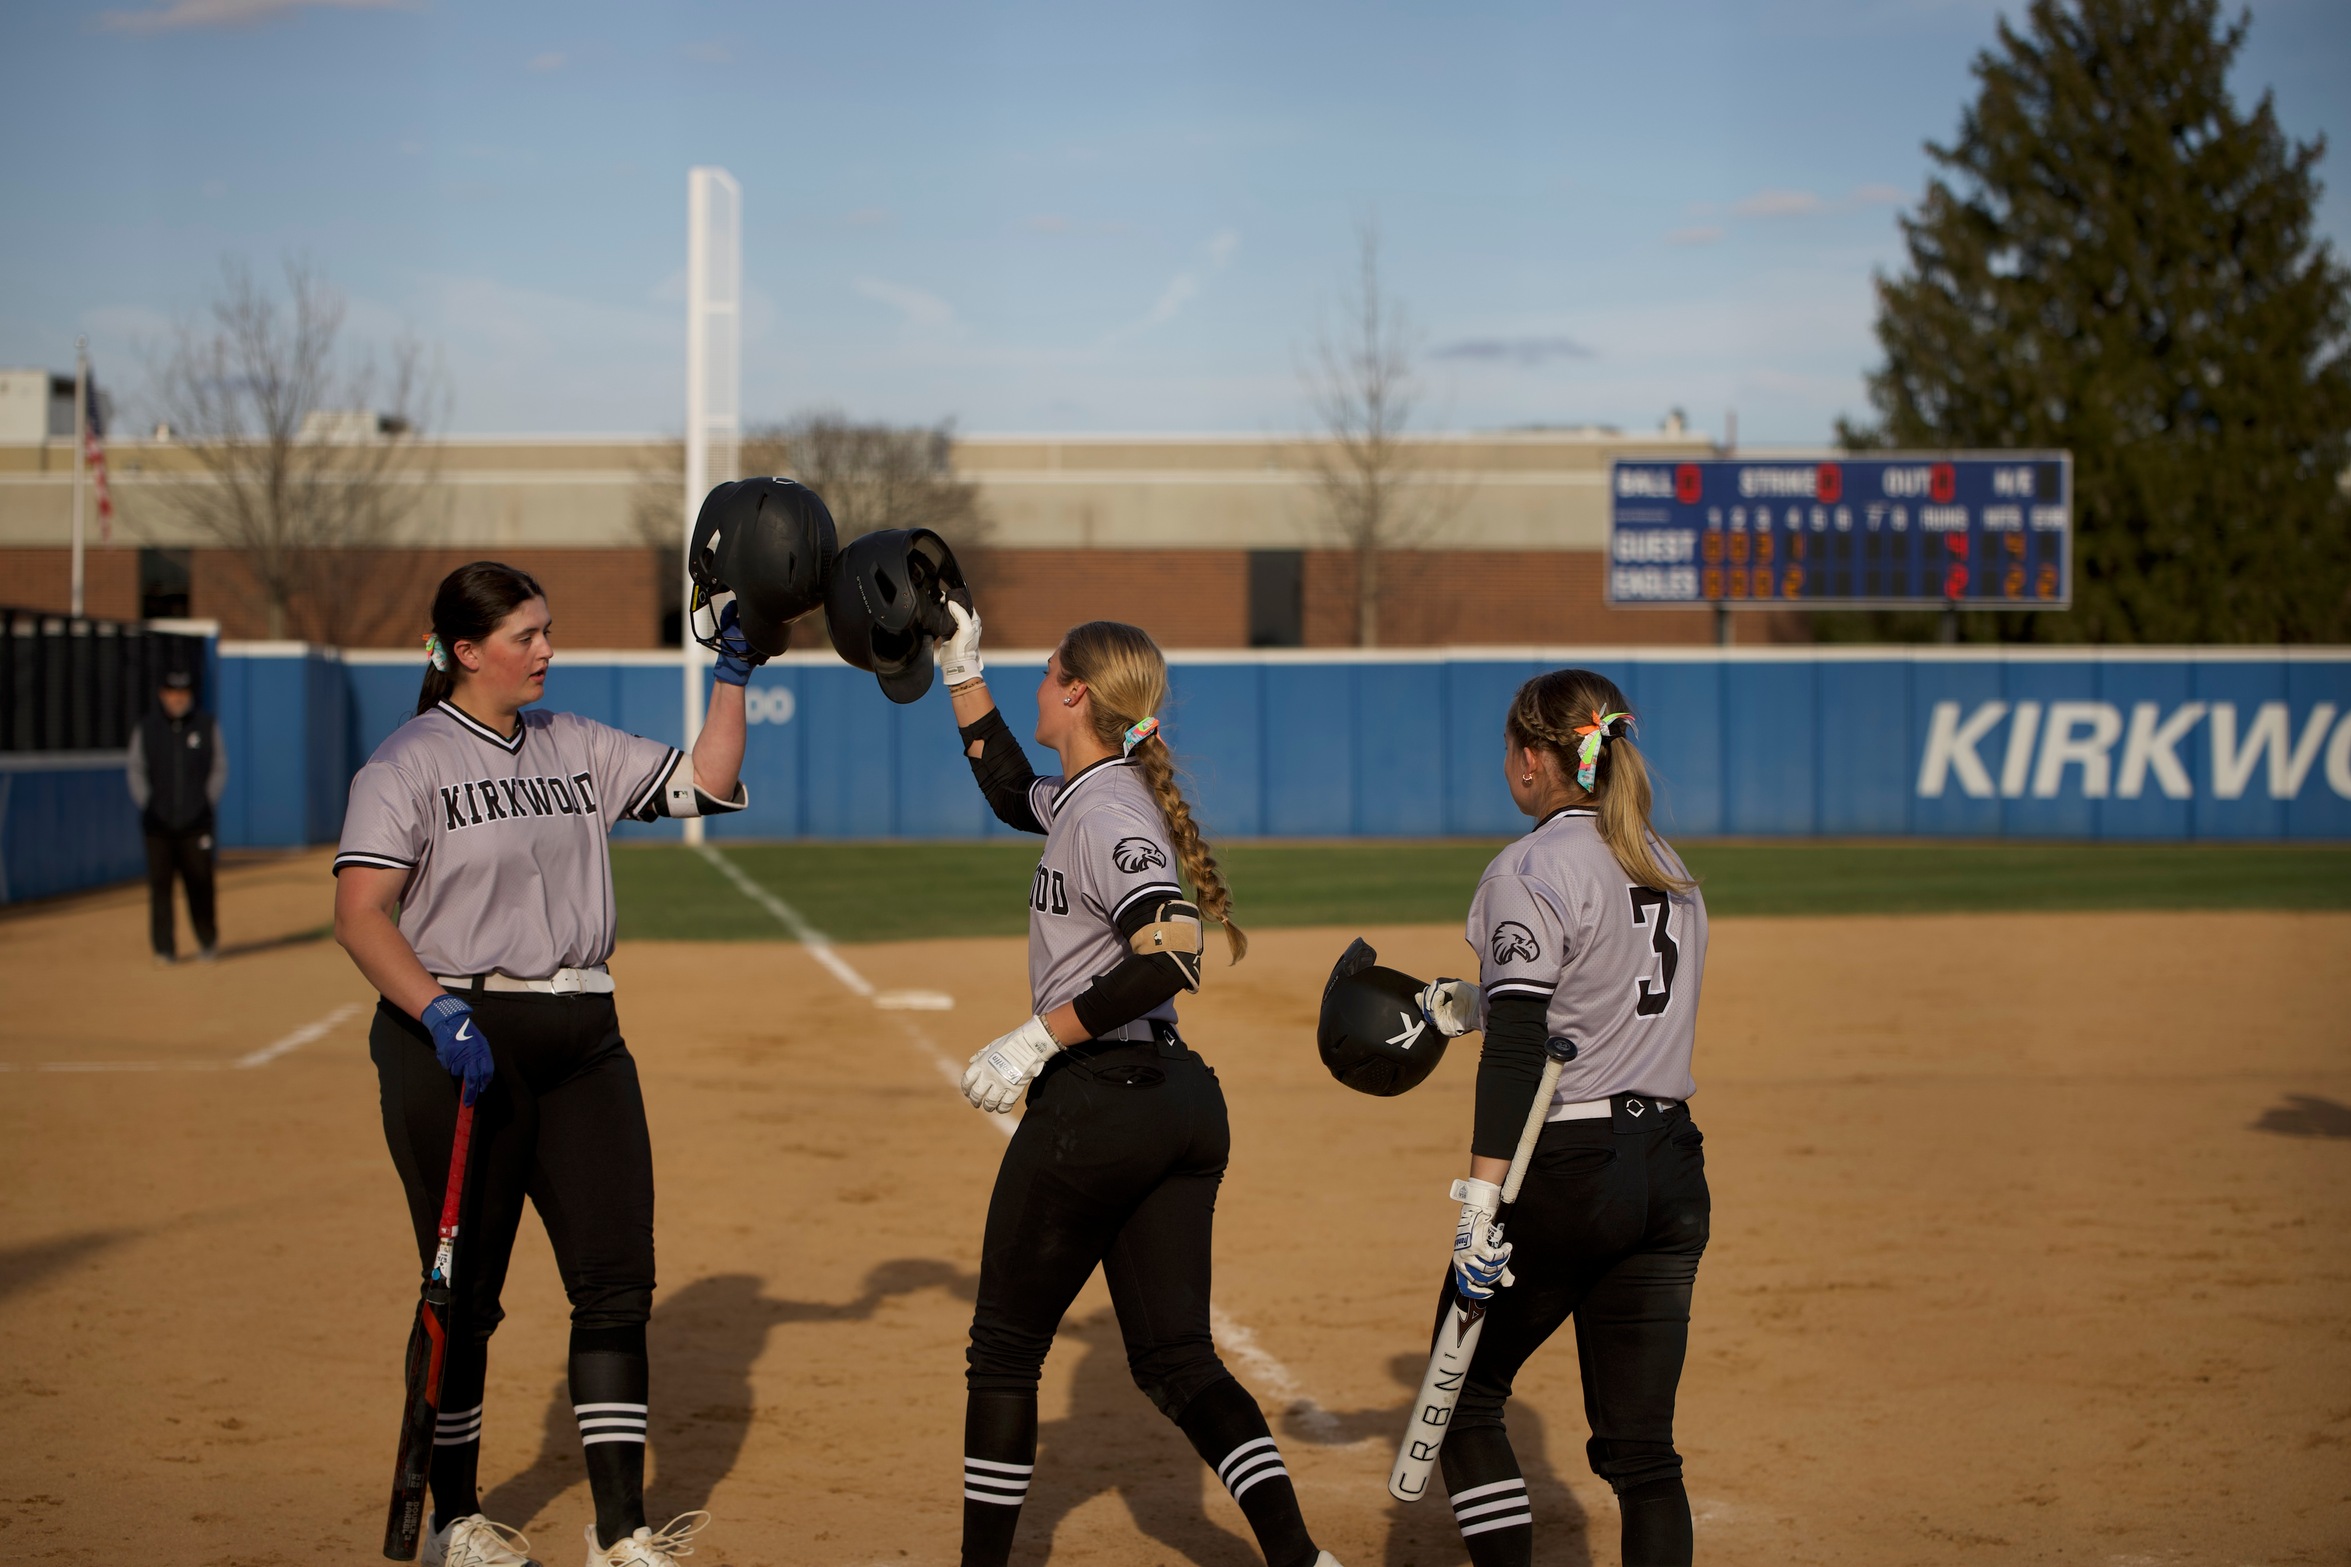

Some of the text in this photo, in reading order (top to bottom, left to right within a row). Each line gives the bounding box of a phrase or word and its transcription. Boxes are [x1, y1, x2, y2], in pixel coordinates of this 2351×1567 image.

[1617, 467, 1674, 498] BALL
[1738, 466, 1818, 498] STRIKE
[1882, 466, 1931, 498] OUT
[1614, 528, 1697, 563] GUEST
[745, 687, 796, 725] 00
[1625, 883, 1680, 1020] 3
